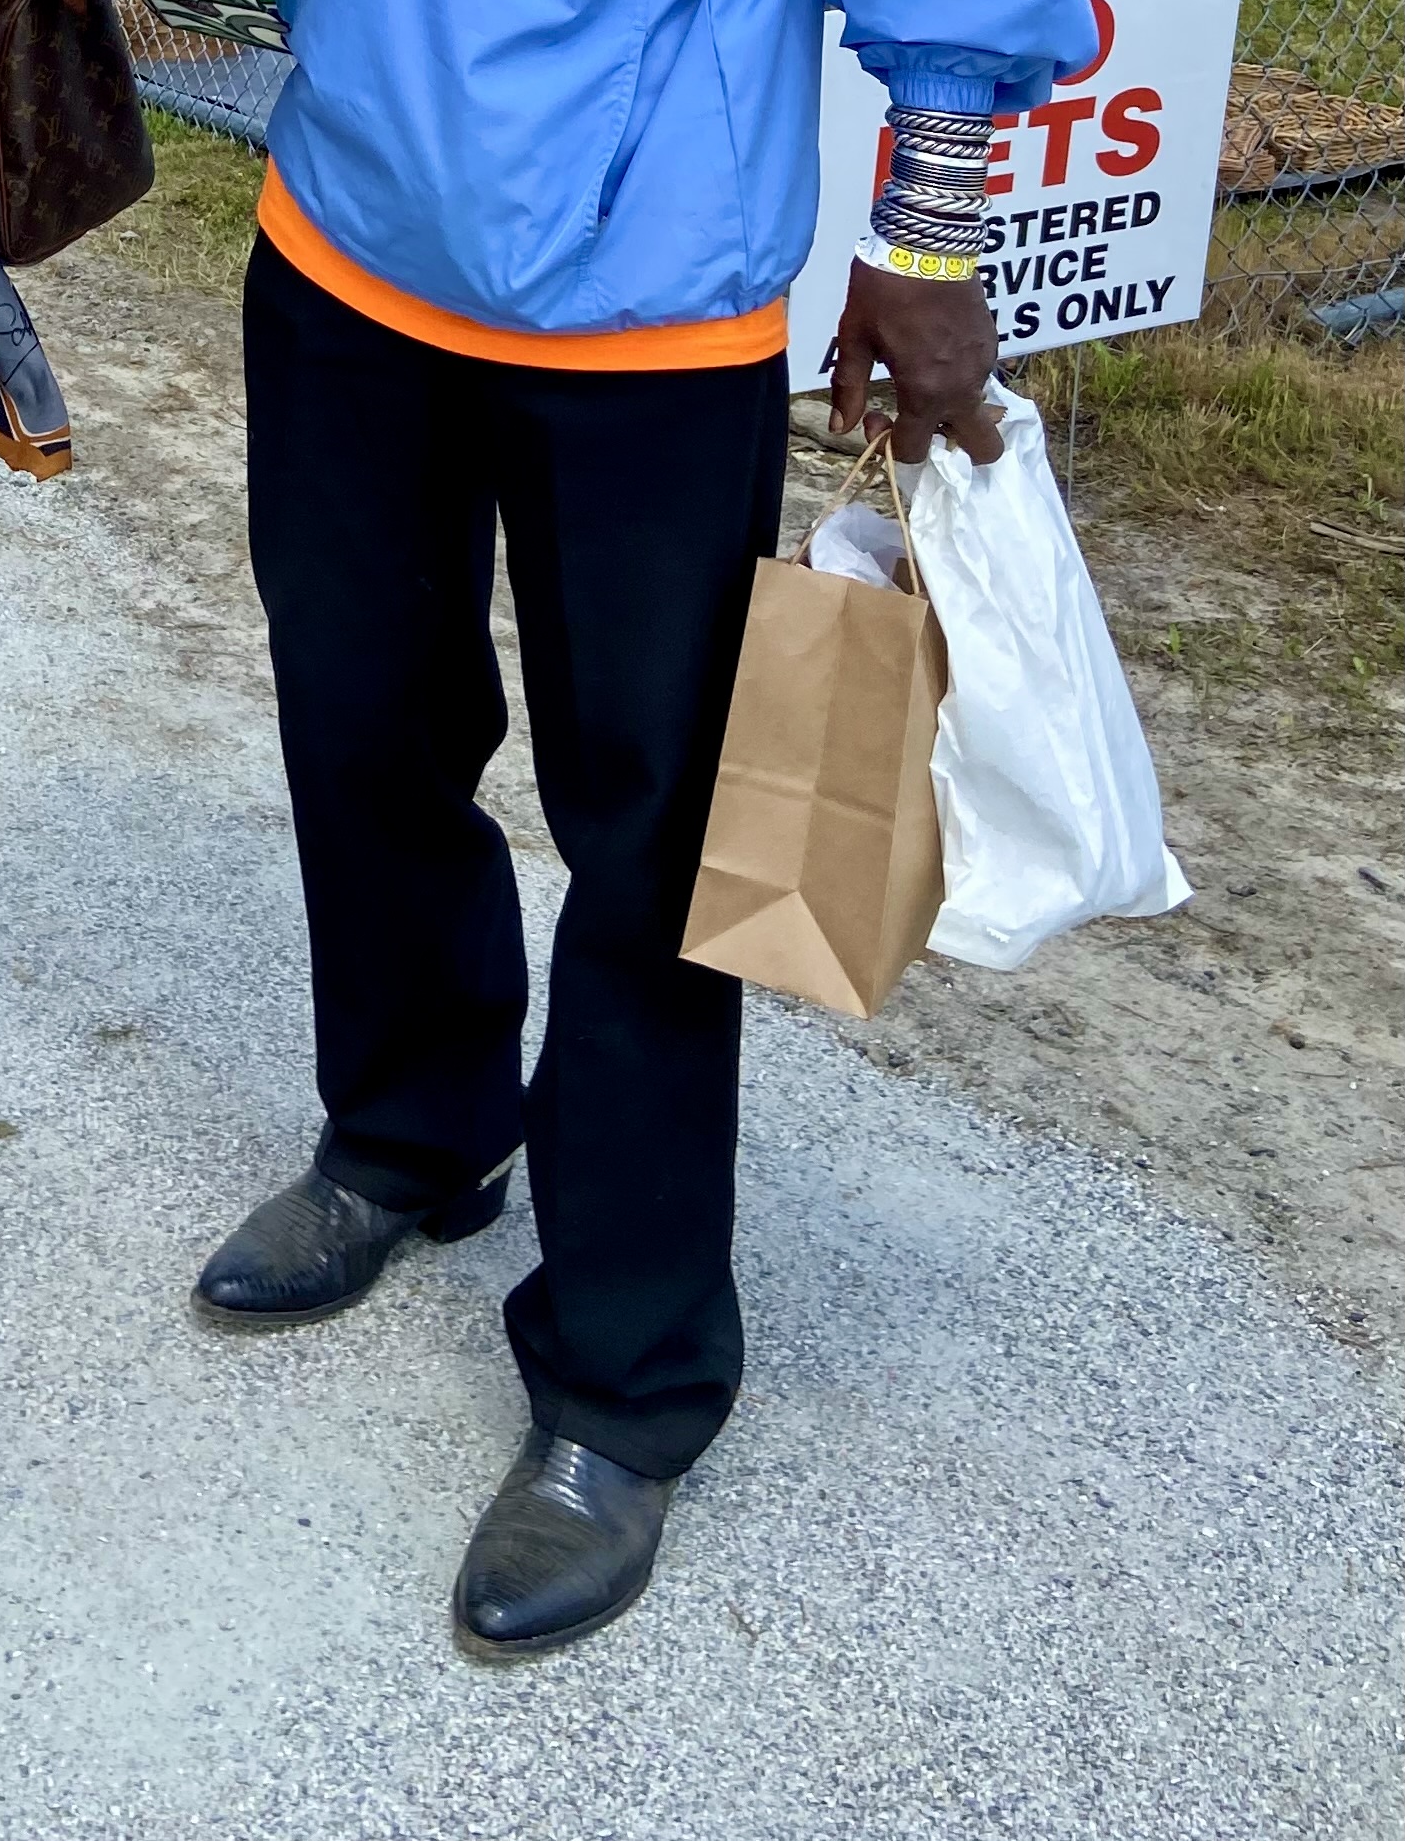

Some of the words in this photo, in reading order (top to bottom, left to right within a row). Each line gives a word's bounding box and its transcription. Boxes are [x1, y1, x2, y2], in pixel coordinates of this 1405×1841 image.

[982, 190, 1162, 254] STERED
[975, 243, 1109, 299] RVICE
[1056, 275, 1176, 330] ONLY
